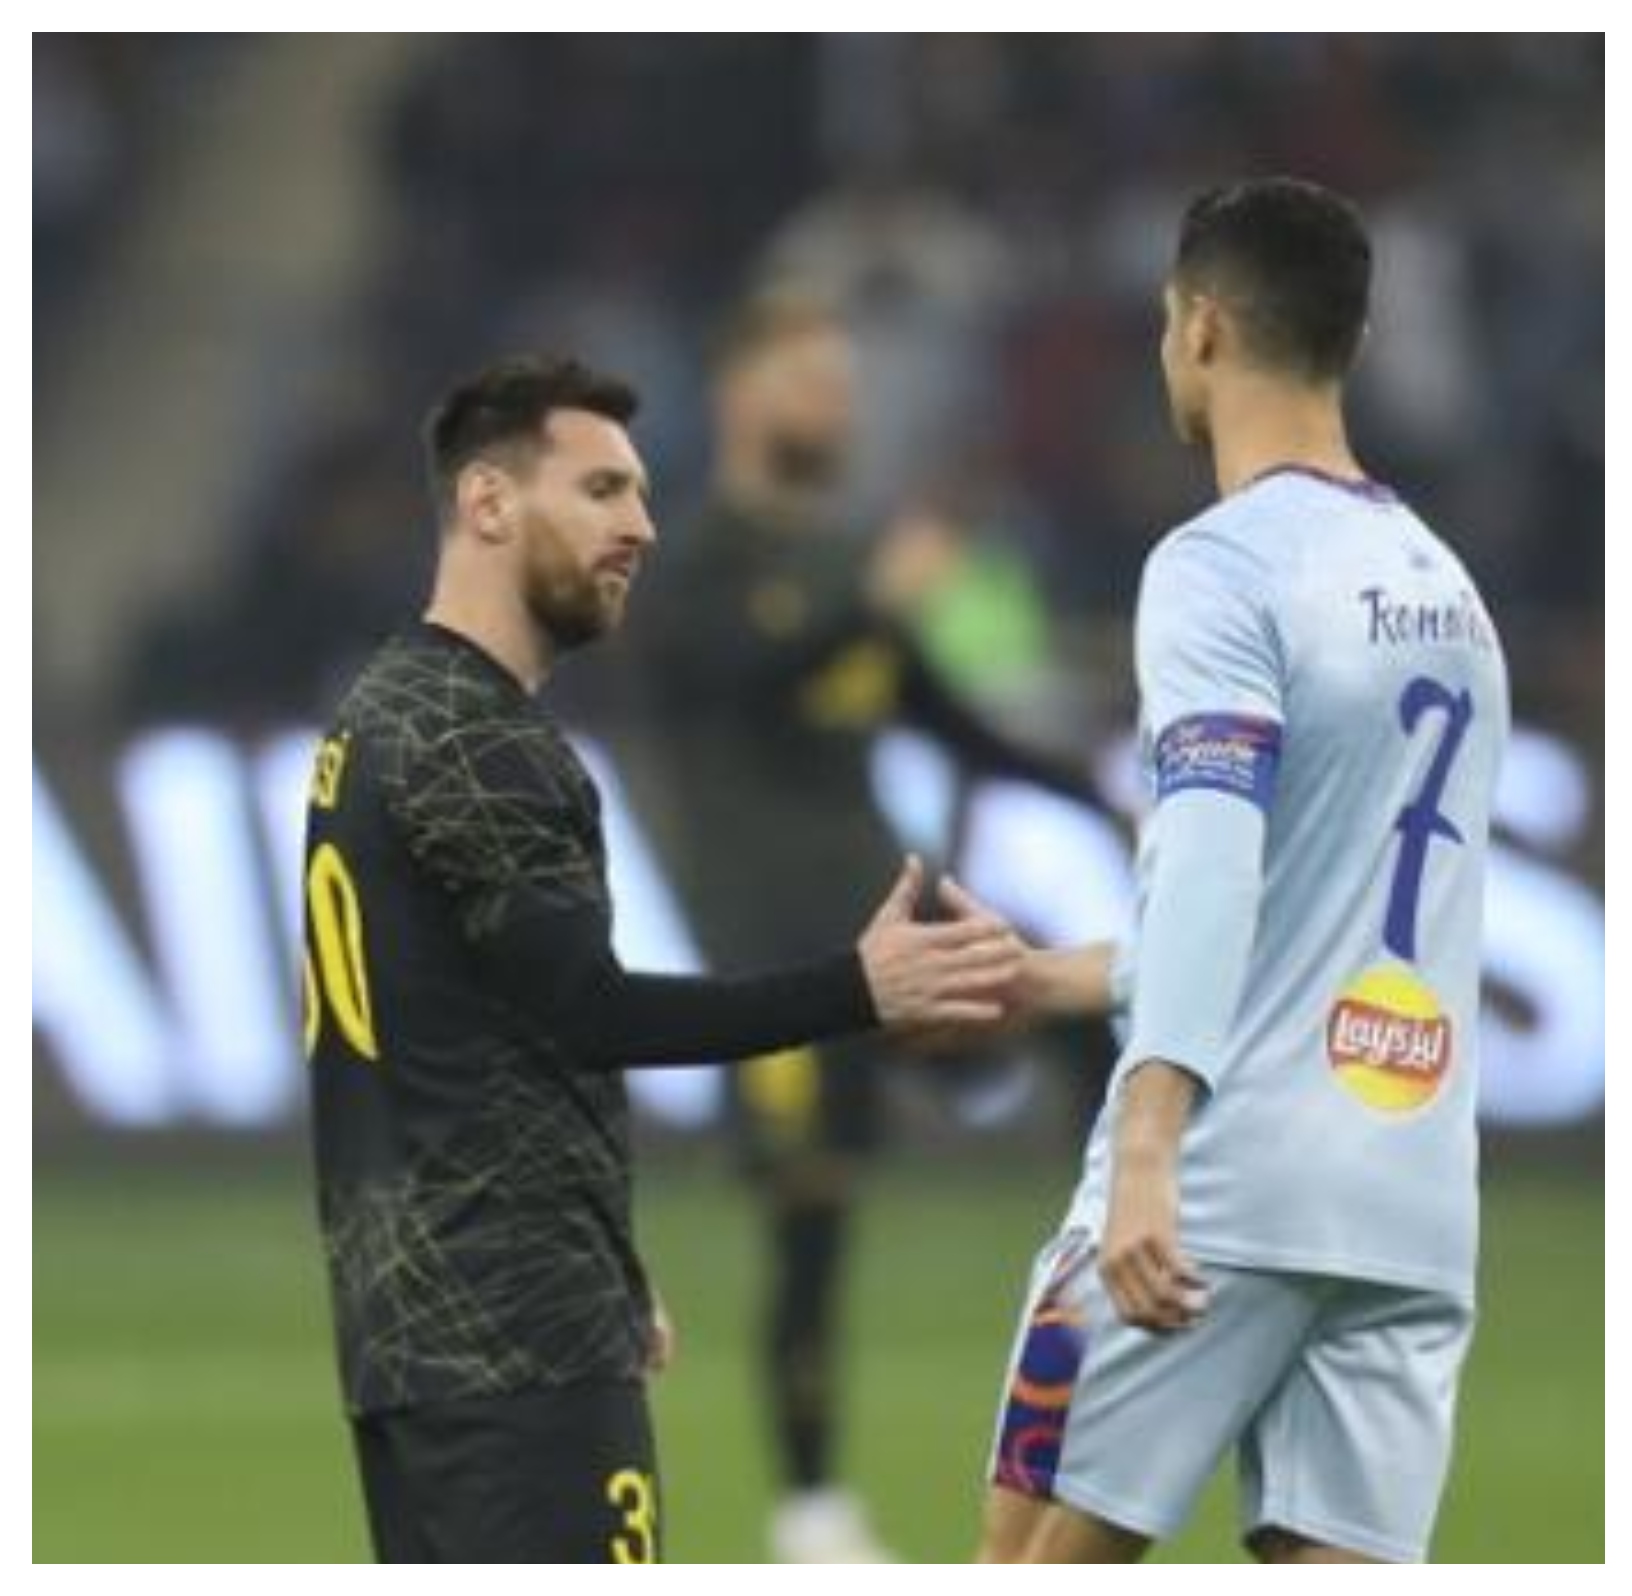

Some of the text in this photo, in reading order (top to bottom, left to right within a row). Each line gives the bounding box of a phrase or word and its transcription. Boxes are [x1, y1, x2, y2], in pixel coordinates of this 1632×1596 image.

[1382, 677, 1474, 960] 7
[304, 843, 378, 1060] 0
[608, 1469, 655, 1563] 3
